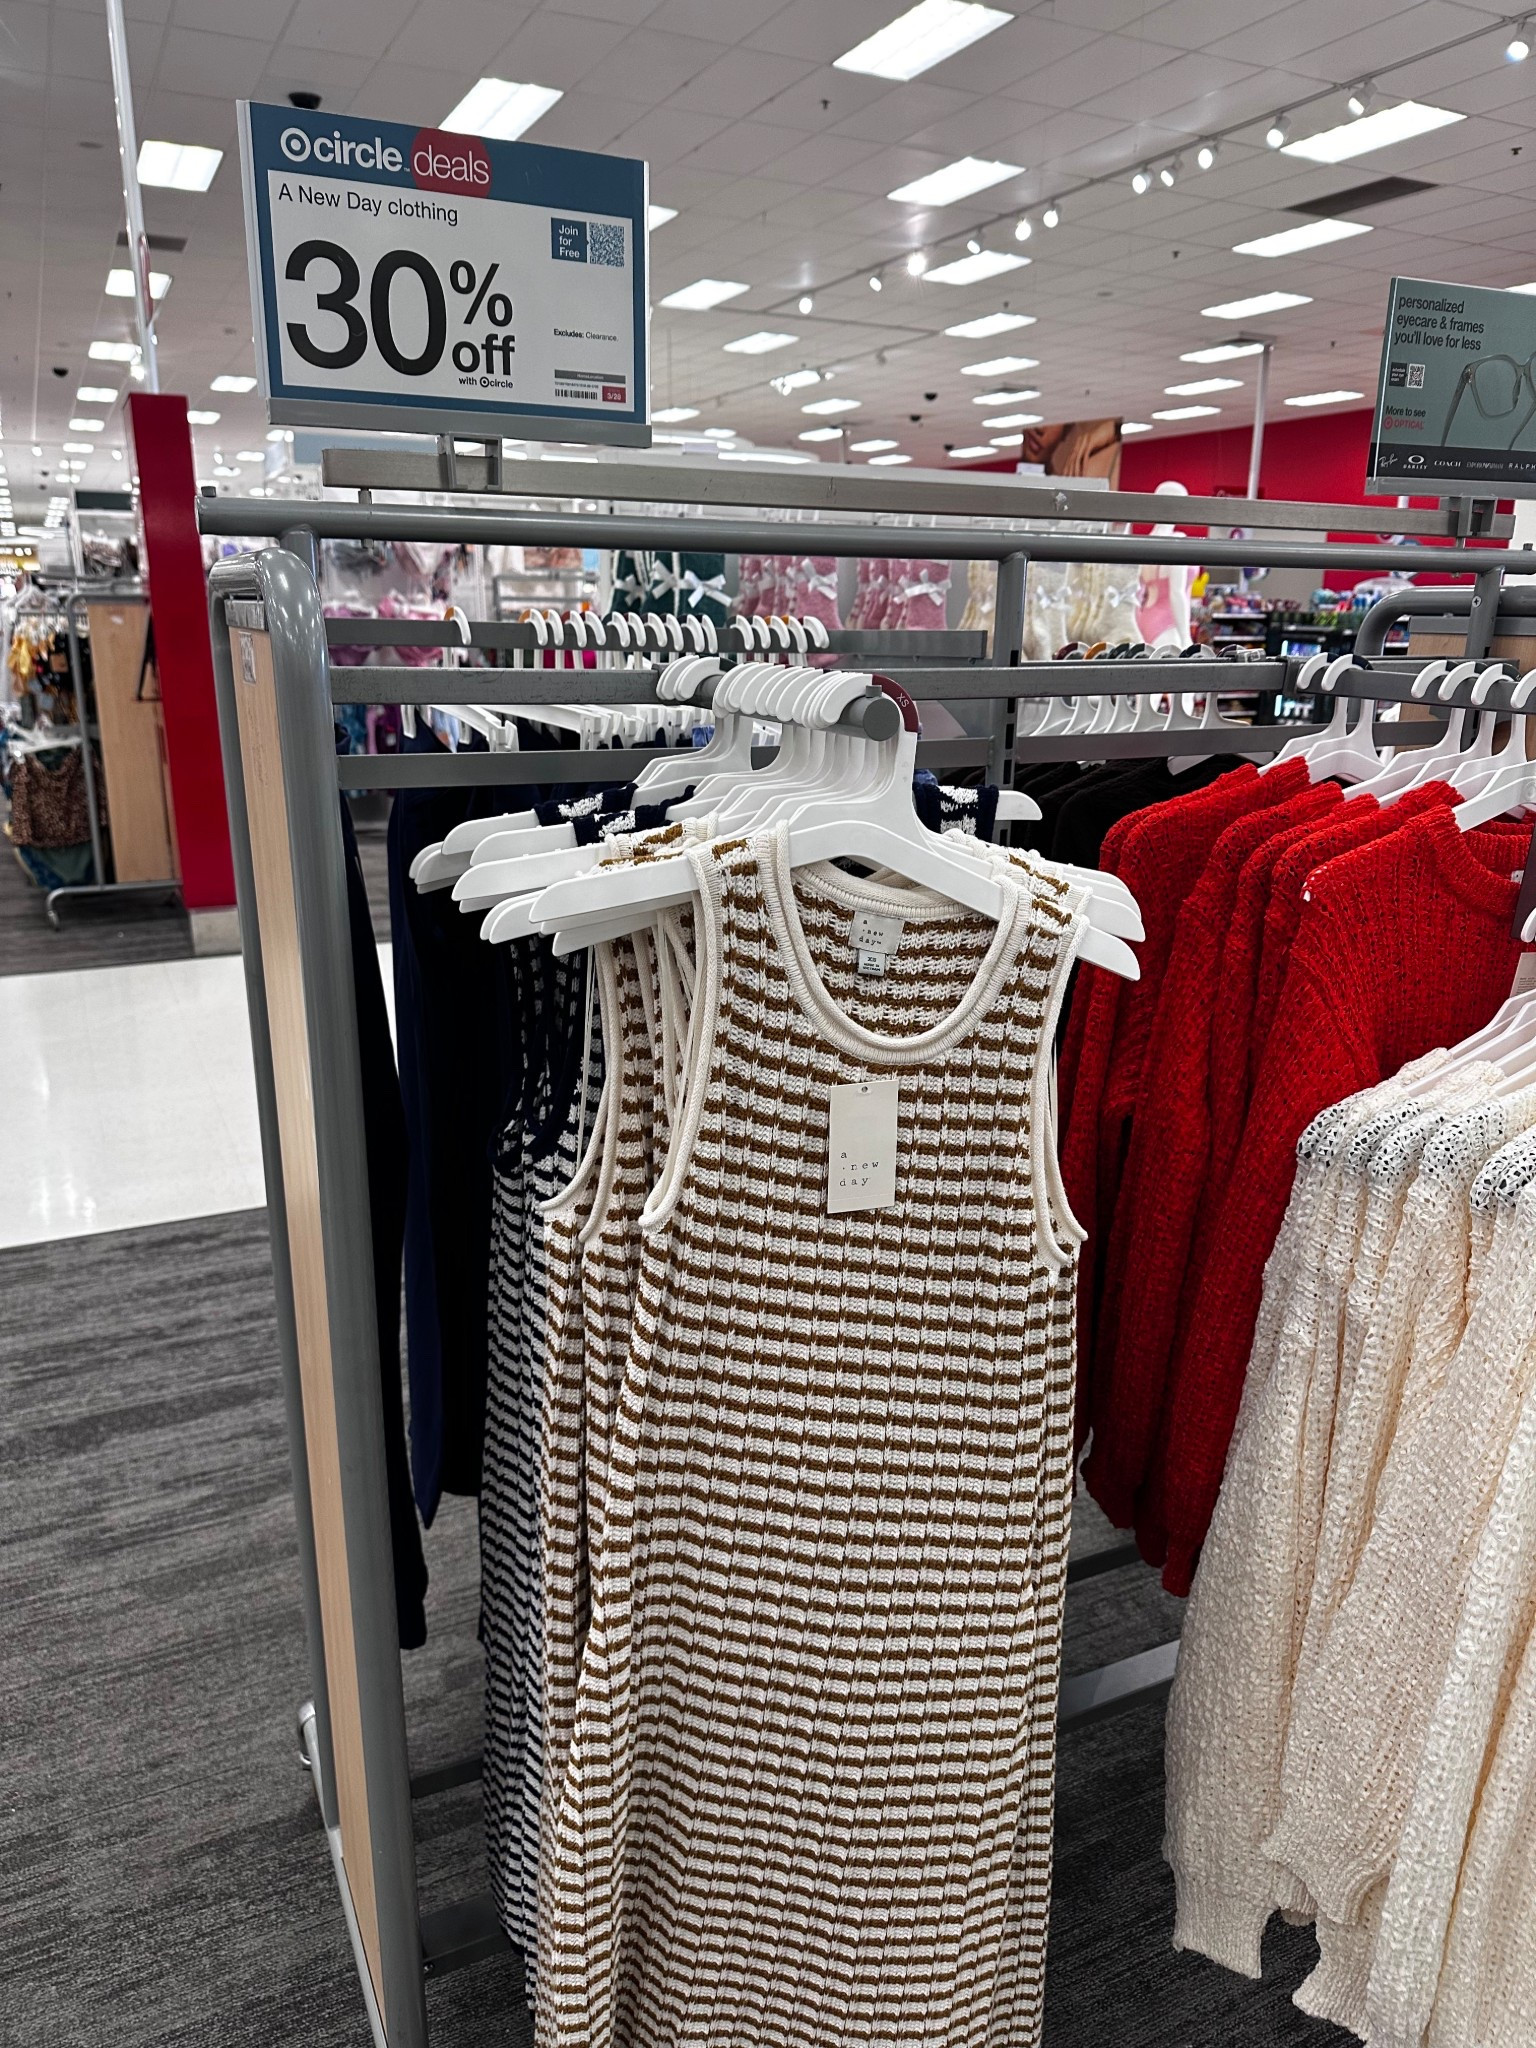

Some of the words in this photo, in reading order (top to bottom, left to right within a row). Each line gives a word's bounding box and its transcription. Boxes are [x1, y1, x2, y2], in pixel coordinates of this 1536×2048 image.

[313, 130, 403, 172] circle
[413, 144, 490, 185] deals
[278, 183, 293, 202] A
[298, 185, 341, 208] New
[347, 191, 382, 217] Day
[388, 198, 458, 226] clothing
[558, 224, 579, 236] Join
[559, 236, 573, 246] for
[559, 246, 580, 258] Free
[1398, 296, 1465, 314] personalized
[1396, 314, 1438, 329] eyecare
[1439, 316, 1448, 330] &
[1449, 317, 1485, 334] frames
[553, 328, 584, 339] Excludes:
[1393, 330, 1422, 346] you'll
[1422, 331, 1444, 346] love
[1445, 334, 1460, 348] for
[1461, 336, 1482, 351] less
[452, 333, 515, 376] off
[458, 377, 478, 386] with
[489, 379, 513, 389] circle
[1385, 405, 1405, 416] More
[1405, 407, 1413, 417] to
[1413, 409, 1427, 418] see
[1394, 418, 1425, 430] OPTICAL
[1434, 460, 1462, 468] COACH
[1508, 462, 1536, 470] RALPH
[896, 693, 910, 708] XS
[839, 1177, 869, 1187] day
